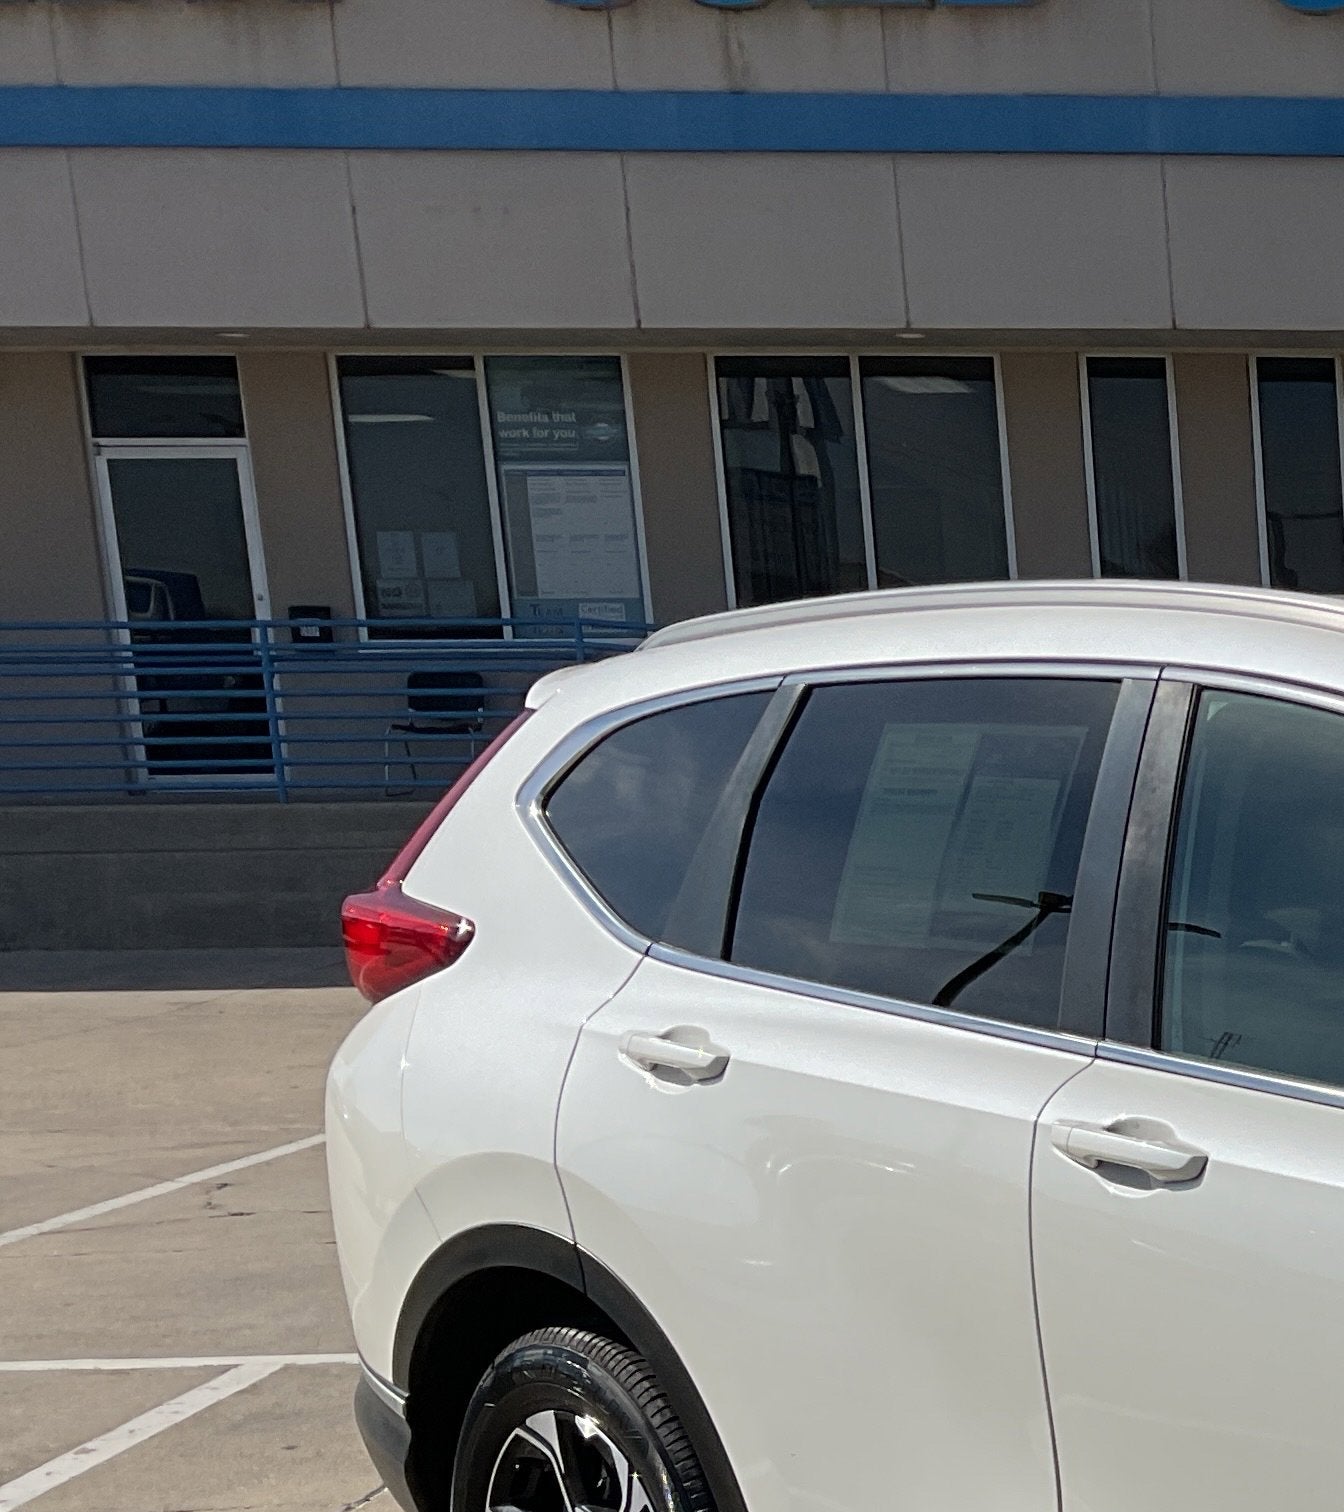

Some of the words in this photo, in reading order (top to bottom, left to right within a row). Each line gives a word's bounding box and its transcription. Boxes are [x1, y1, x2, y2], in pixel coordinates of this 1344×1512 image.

[551, 411, 577, 422] that
[499, 427, 530, 439] work
[532, 426, 549, 438] for
